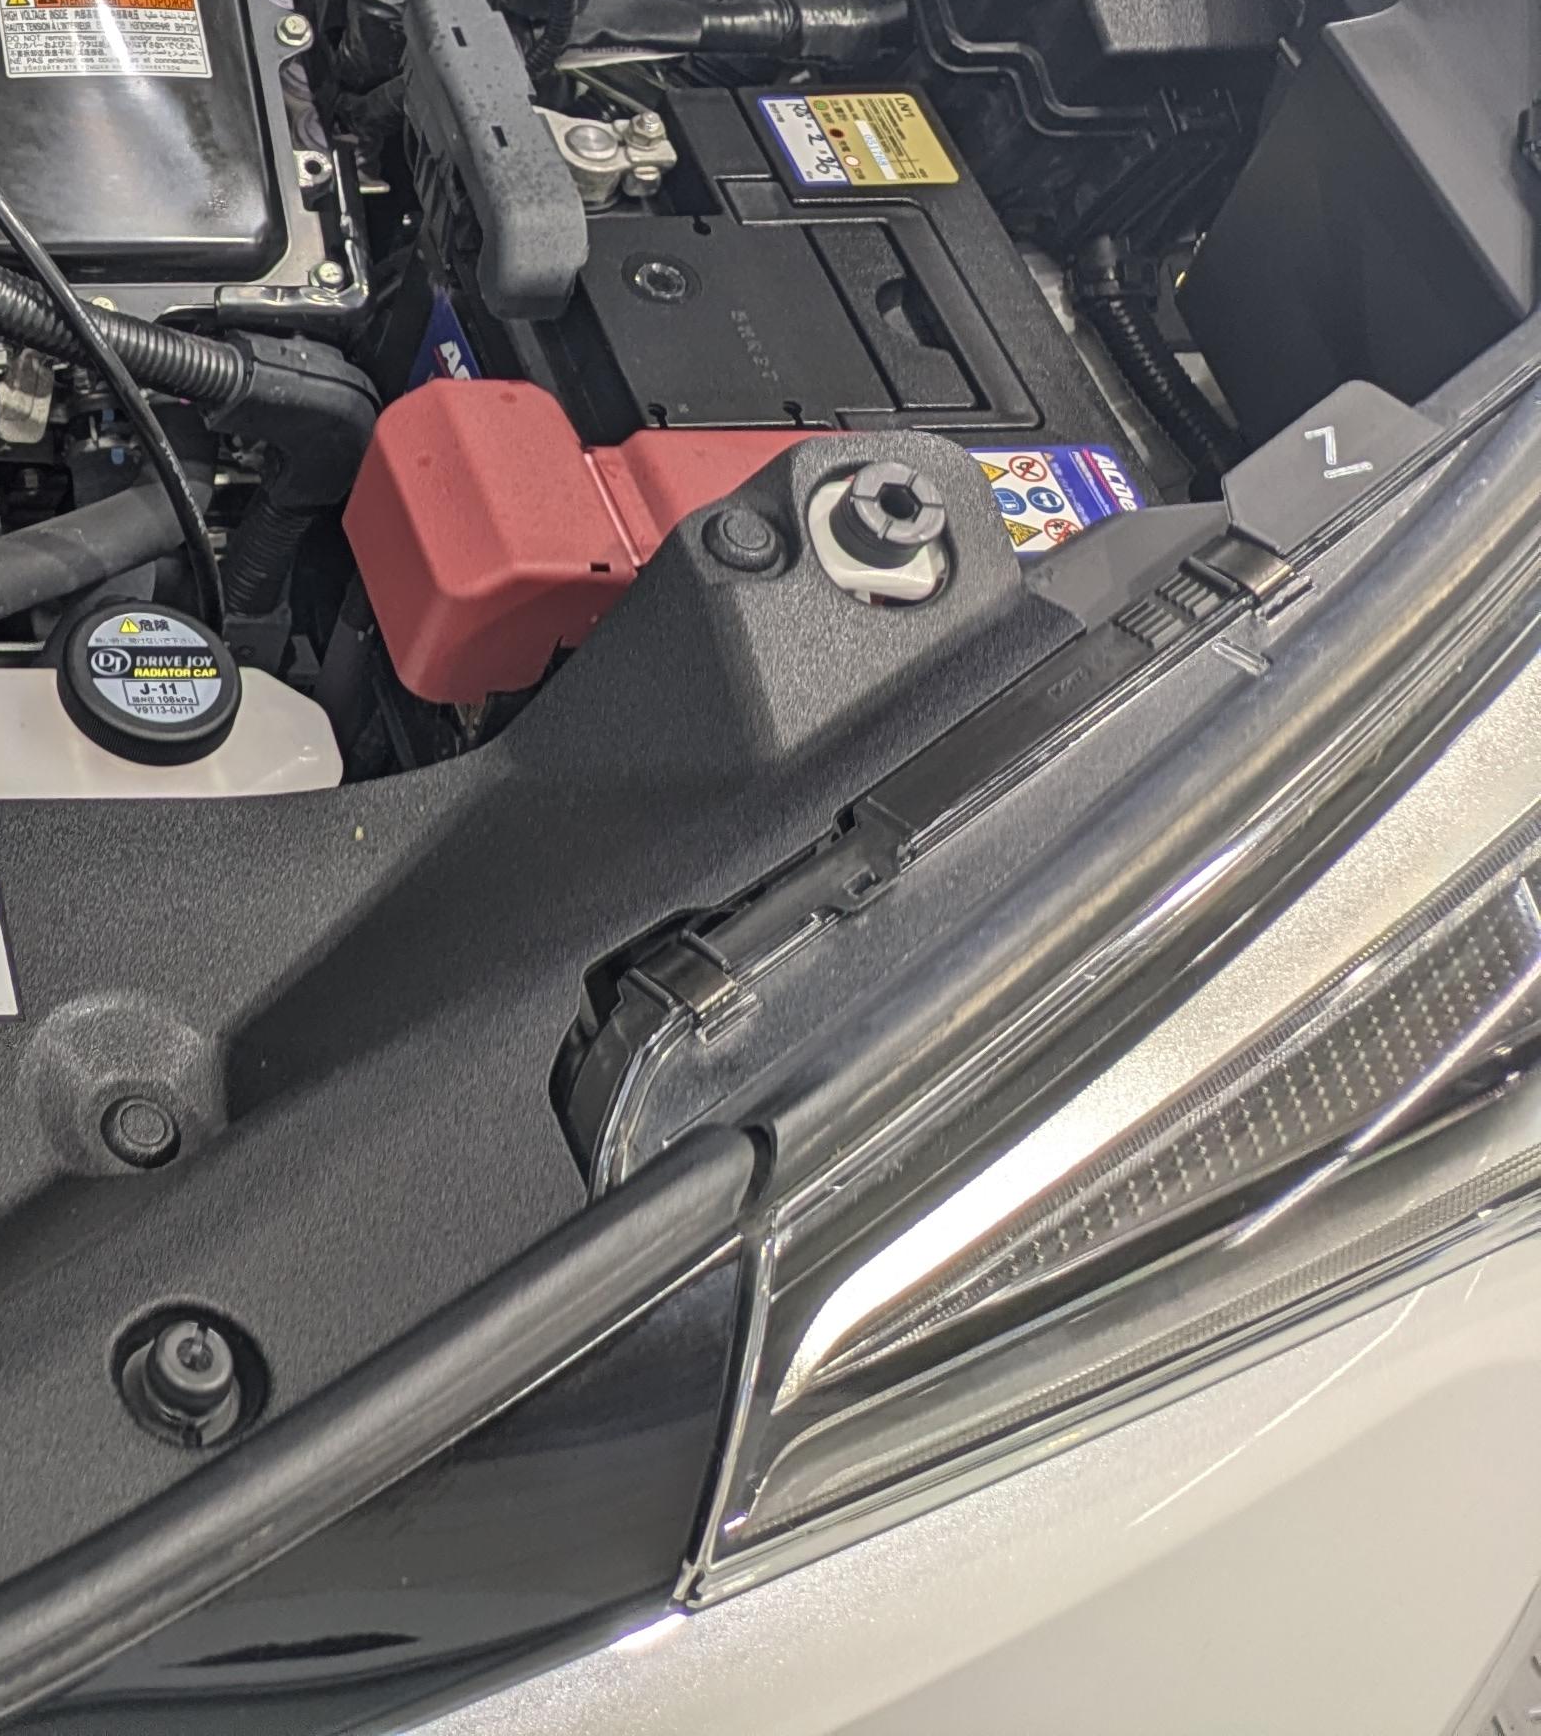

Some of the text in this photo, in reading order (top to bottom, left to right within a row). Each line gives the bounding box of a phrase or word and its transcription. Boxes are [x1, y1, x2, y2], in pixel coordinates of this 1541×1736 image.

[3, 10, 18, 21] HIGH
[20, 9, 47, 21] VOLTAGE
[48, 9, 69, 19] INSIDE
[4, 22, 25, 32] HAUTE
[25, 22, 50, 31] TENSION
[23, 34, 40, 42] NOT
[894, 97, 916, 118] LN1
[138, 619, 171, 632] 危険
[135, 655, 214, 668] DRIVE JOY
[133, 668, 217, 678] RADIATOR CAP
[139, 682, 178, 695] J-11
[157, 695, 194, 704] 108kPa
[134, 705, 196, 715] V9113-0J11
